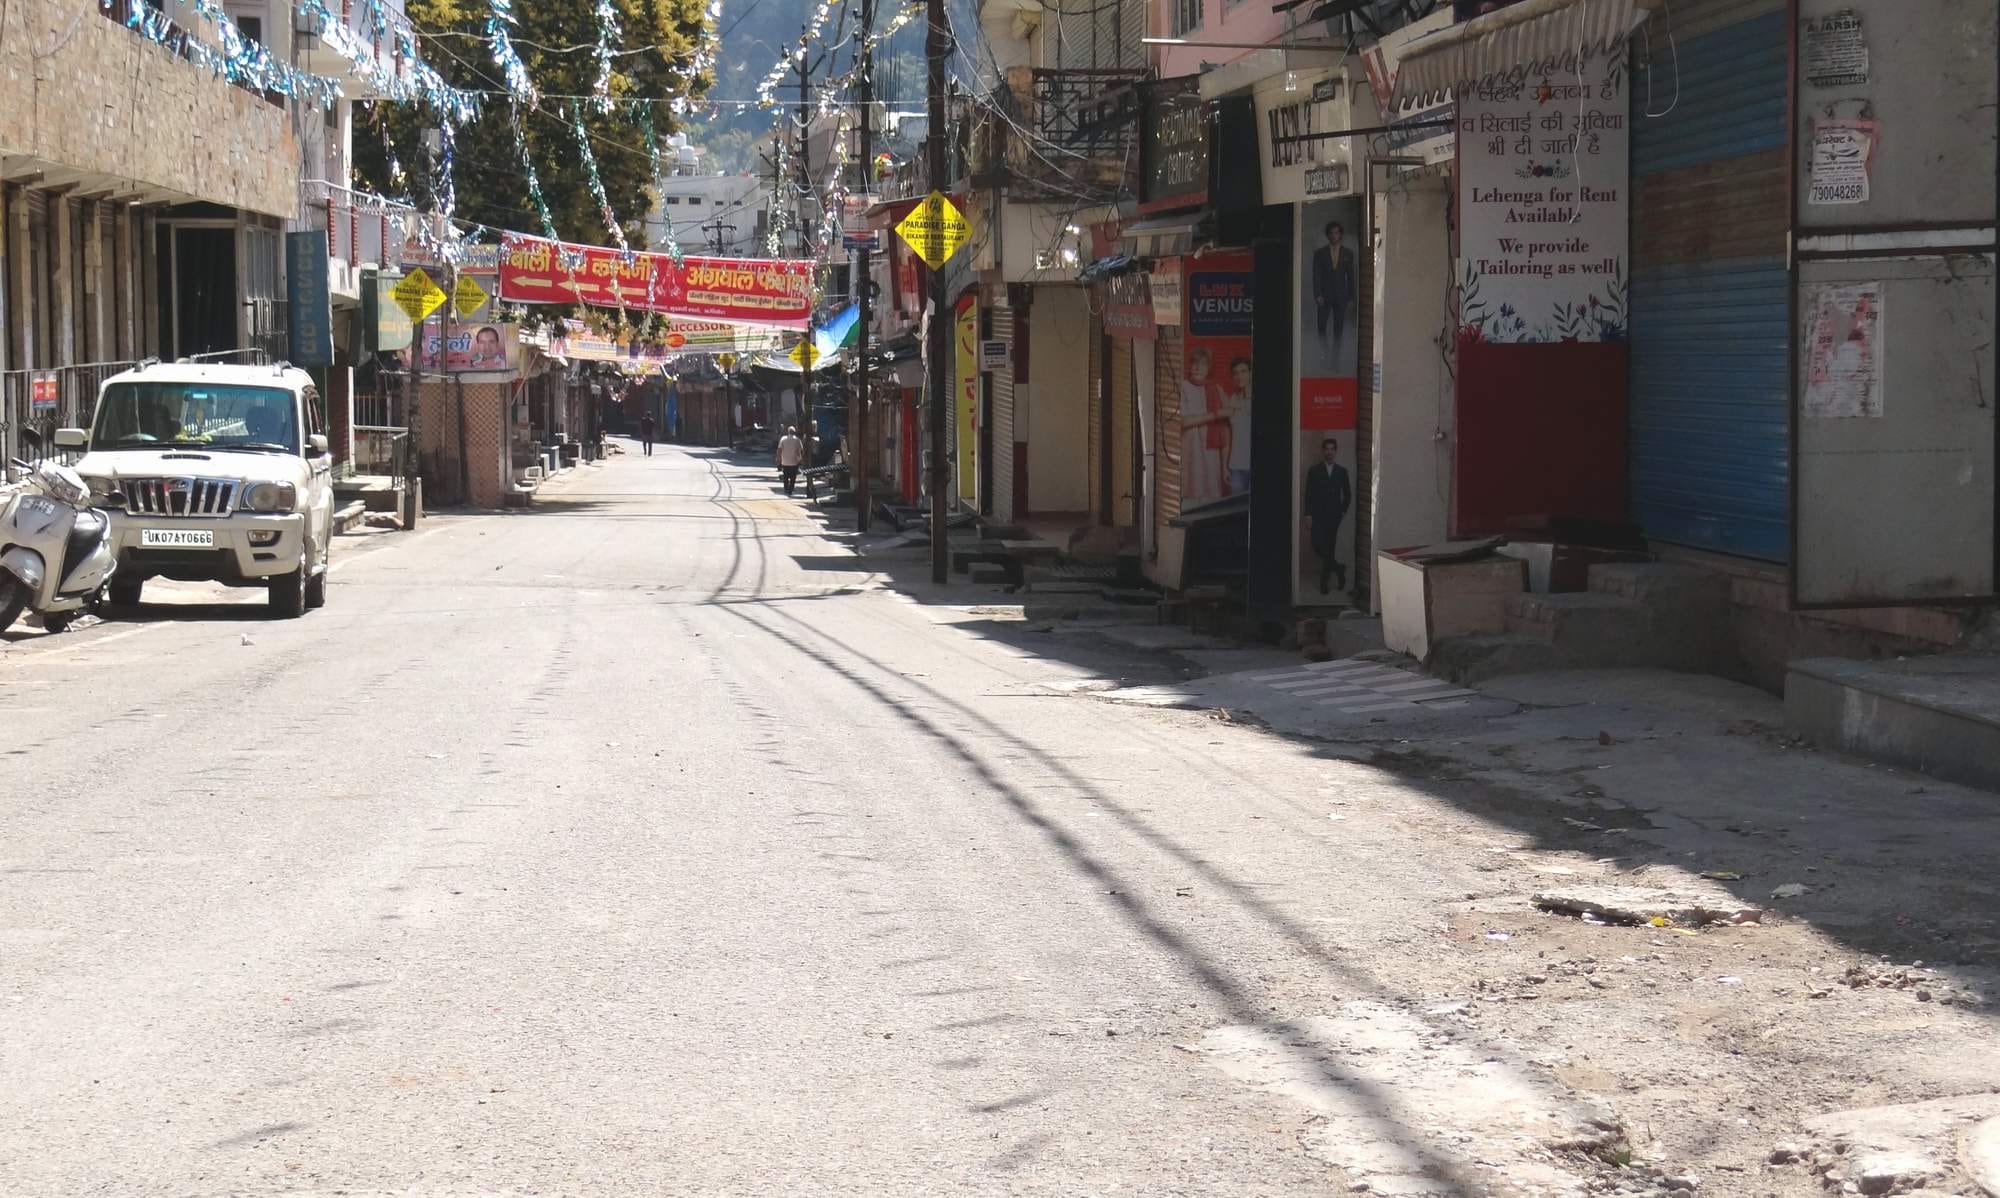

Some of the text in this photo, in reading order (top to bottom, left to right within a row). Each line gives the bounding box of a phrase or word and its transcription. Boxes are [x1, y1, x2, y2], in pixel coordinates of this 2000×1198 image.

[1599, 78, 1613, 101] है
[1461, 111, 1624, 137] व सिलाई की सुविधा
[1487, 135, 1505, 155] भी
[1514, 136, 1532, 155] दी
[1587, 133, 1600, 154] है
[1472, 186, 1617, 207] Lehenga for Rent
[905, 221, 966, 231] PARADISE GANGA
[1505, 208, 1582, 224] Available
[1498, 238, 1590, 258] We provide
[687, 266, 754, 291] अग्रवाल
[1477, 258, 1614, 279] Tailoring as well
[1193, 298, 1254, 312] VENUS
[148, 532, 212, 544] UK07AY0666
